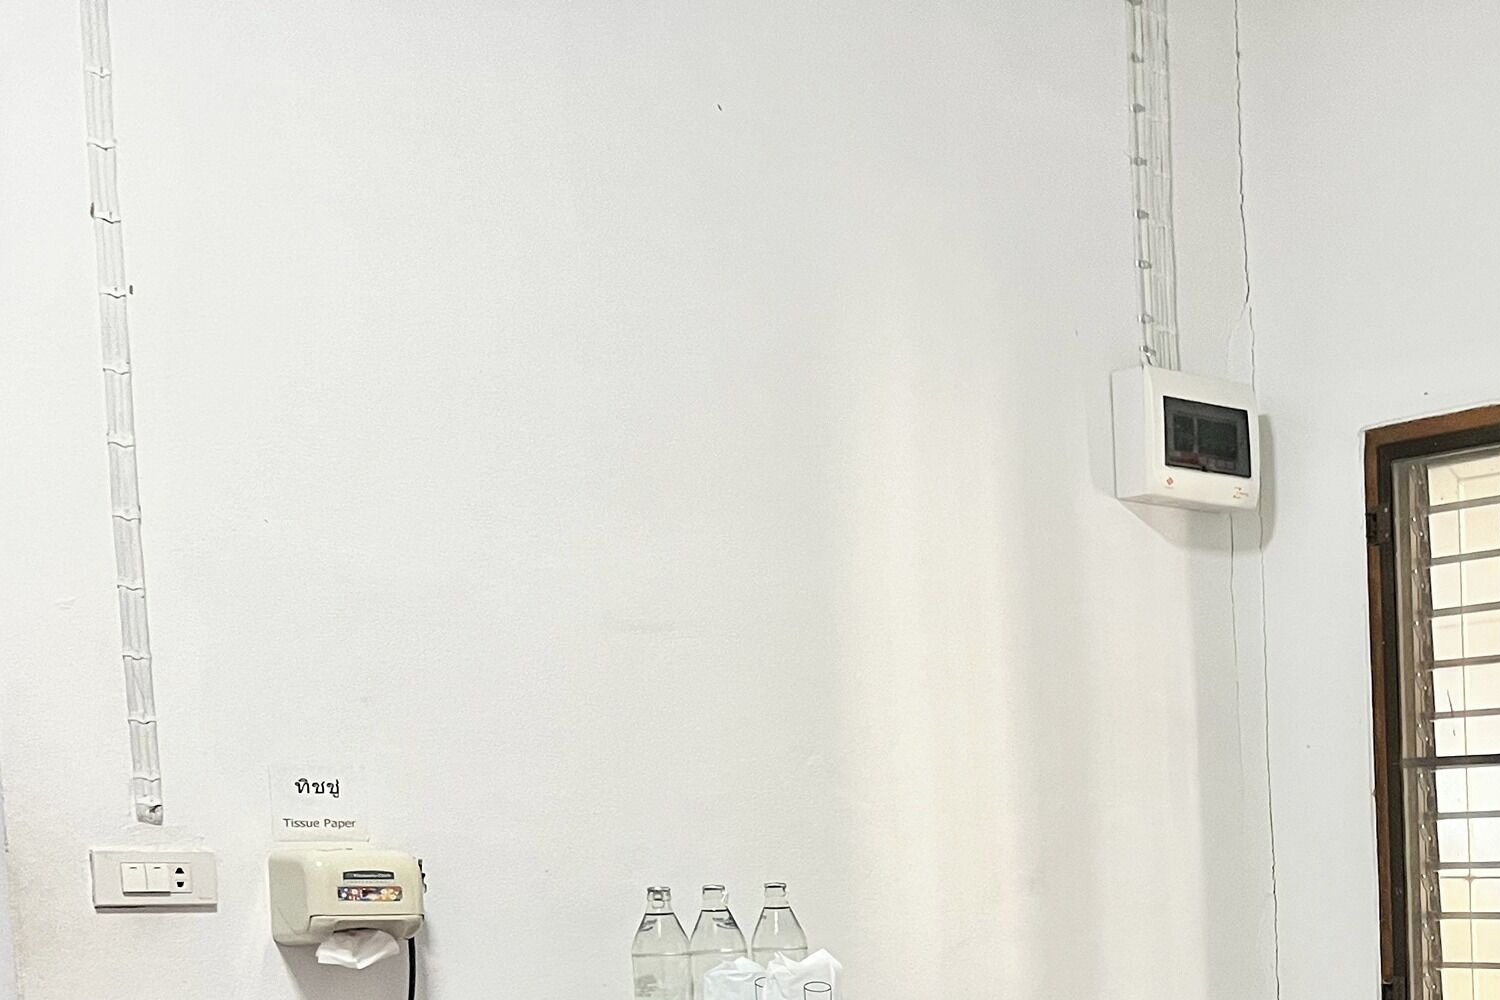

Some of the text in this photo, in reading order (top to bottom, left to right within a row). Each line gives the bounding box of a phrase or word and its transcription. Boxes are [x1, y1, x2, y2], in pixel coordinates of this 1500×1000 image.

[294, 777, 340, 798] ทิชชู่
[282, 818, 357, 830] Tissue Paper
